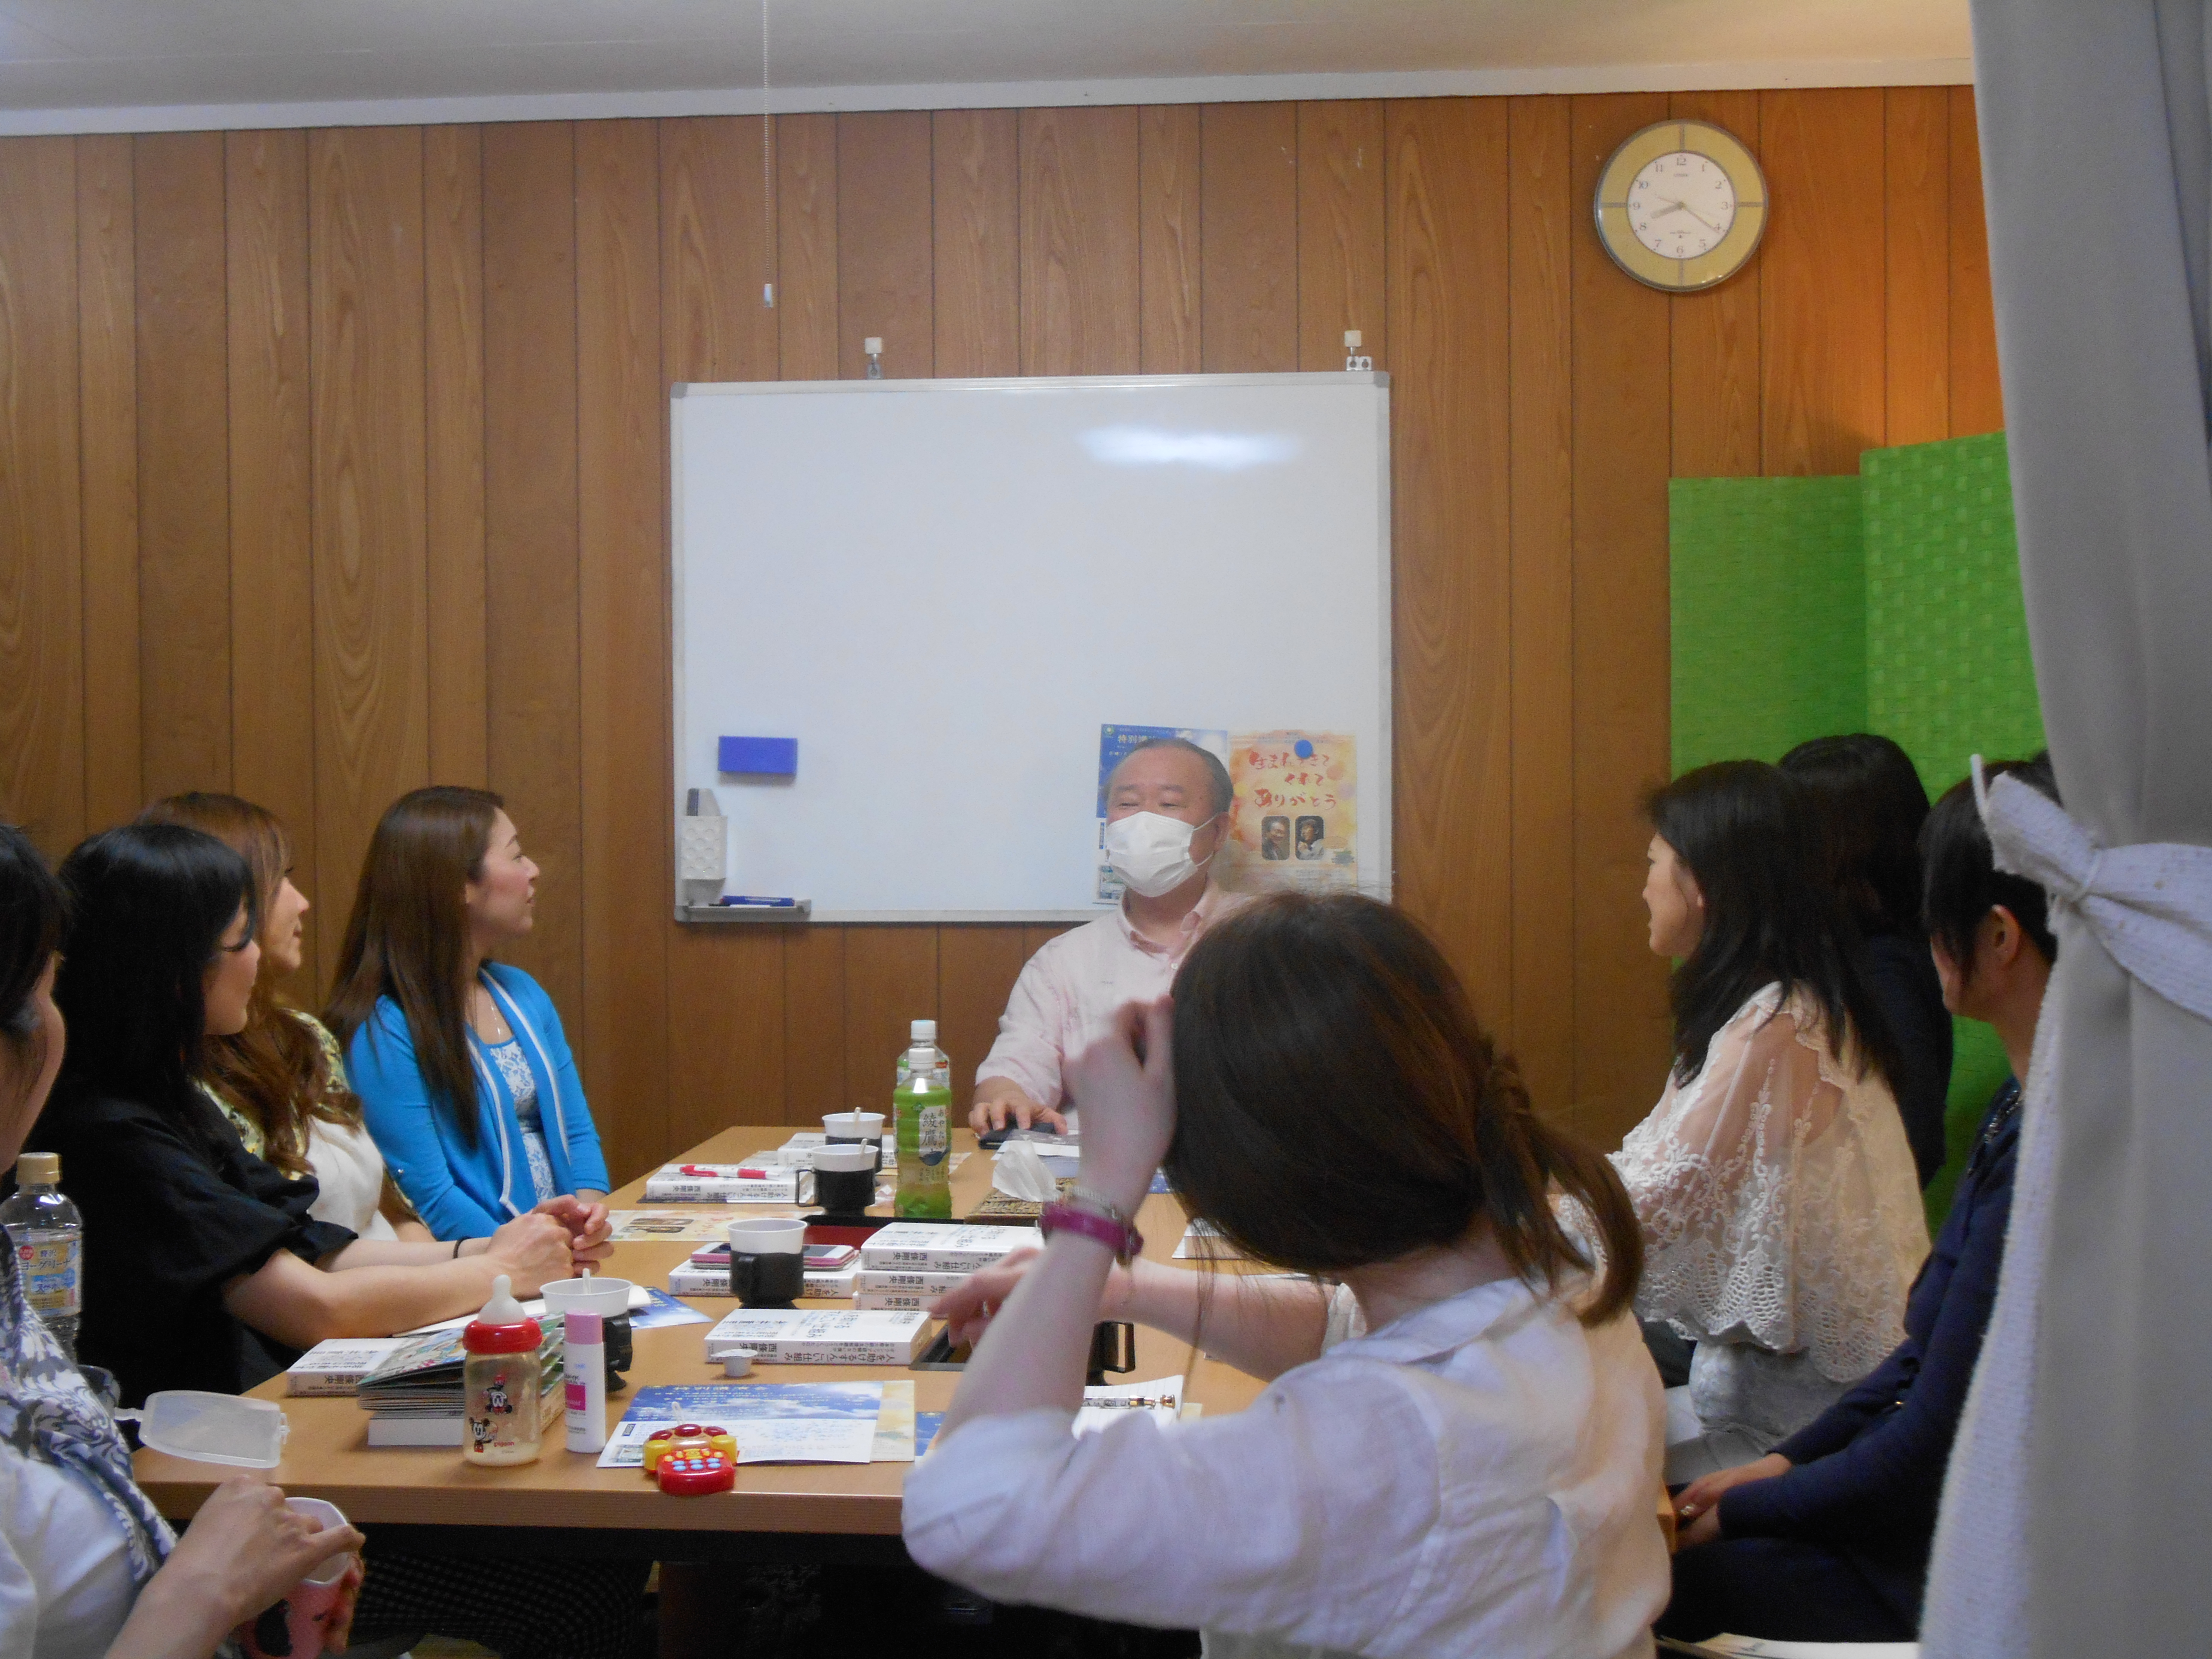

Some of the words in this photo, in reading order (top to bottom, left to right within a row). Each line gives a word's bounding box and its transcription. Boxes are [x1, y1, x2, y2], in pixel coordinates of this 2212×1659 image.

[1676, 157, 1687, 166] 12
[1638, 180, 1649, 189] 10
[1715, 180, 1722, 189] 2
[1633, 201, 1641, 210] 9
[1721, 201, 1729, 210] 3
[1639, 222, 1647, 231] 8
[1655, 239, 1662, 248] 7
[1698, 239, 1706, 248] 5
[1676, 246, 1683, 254] 6
[1285, 772, 1324, 786] くれて
[1254, 787, 1336, 810] ありがとう
[893, 1252, 927, 1261] 西條剛央
[889, 1275, 924, 1285] 西條剛央
[885, 1297, 920, 1307] 西條剛央
[784, 1352, 895, 1362] 人を助けるすんごい仕組み
